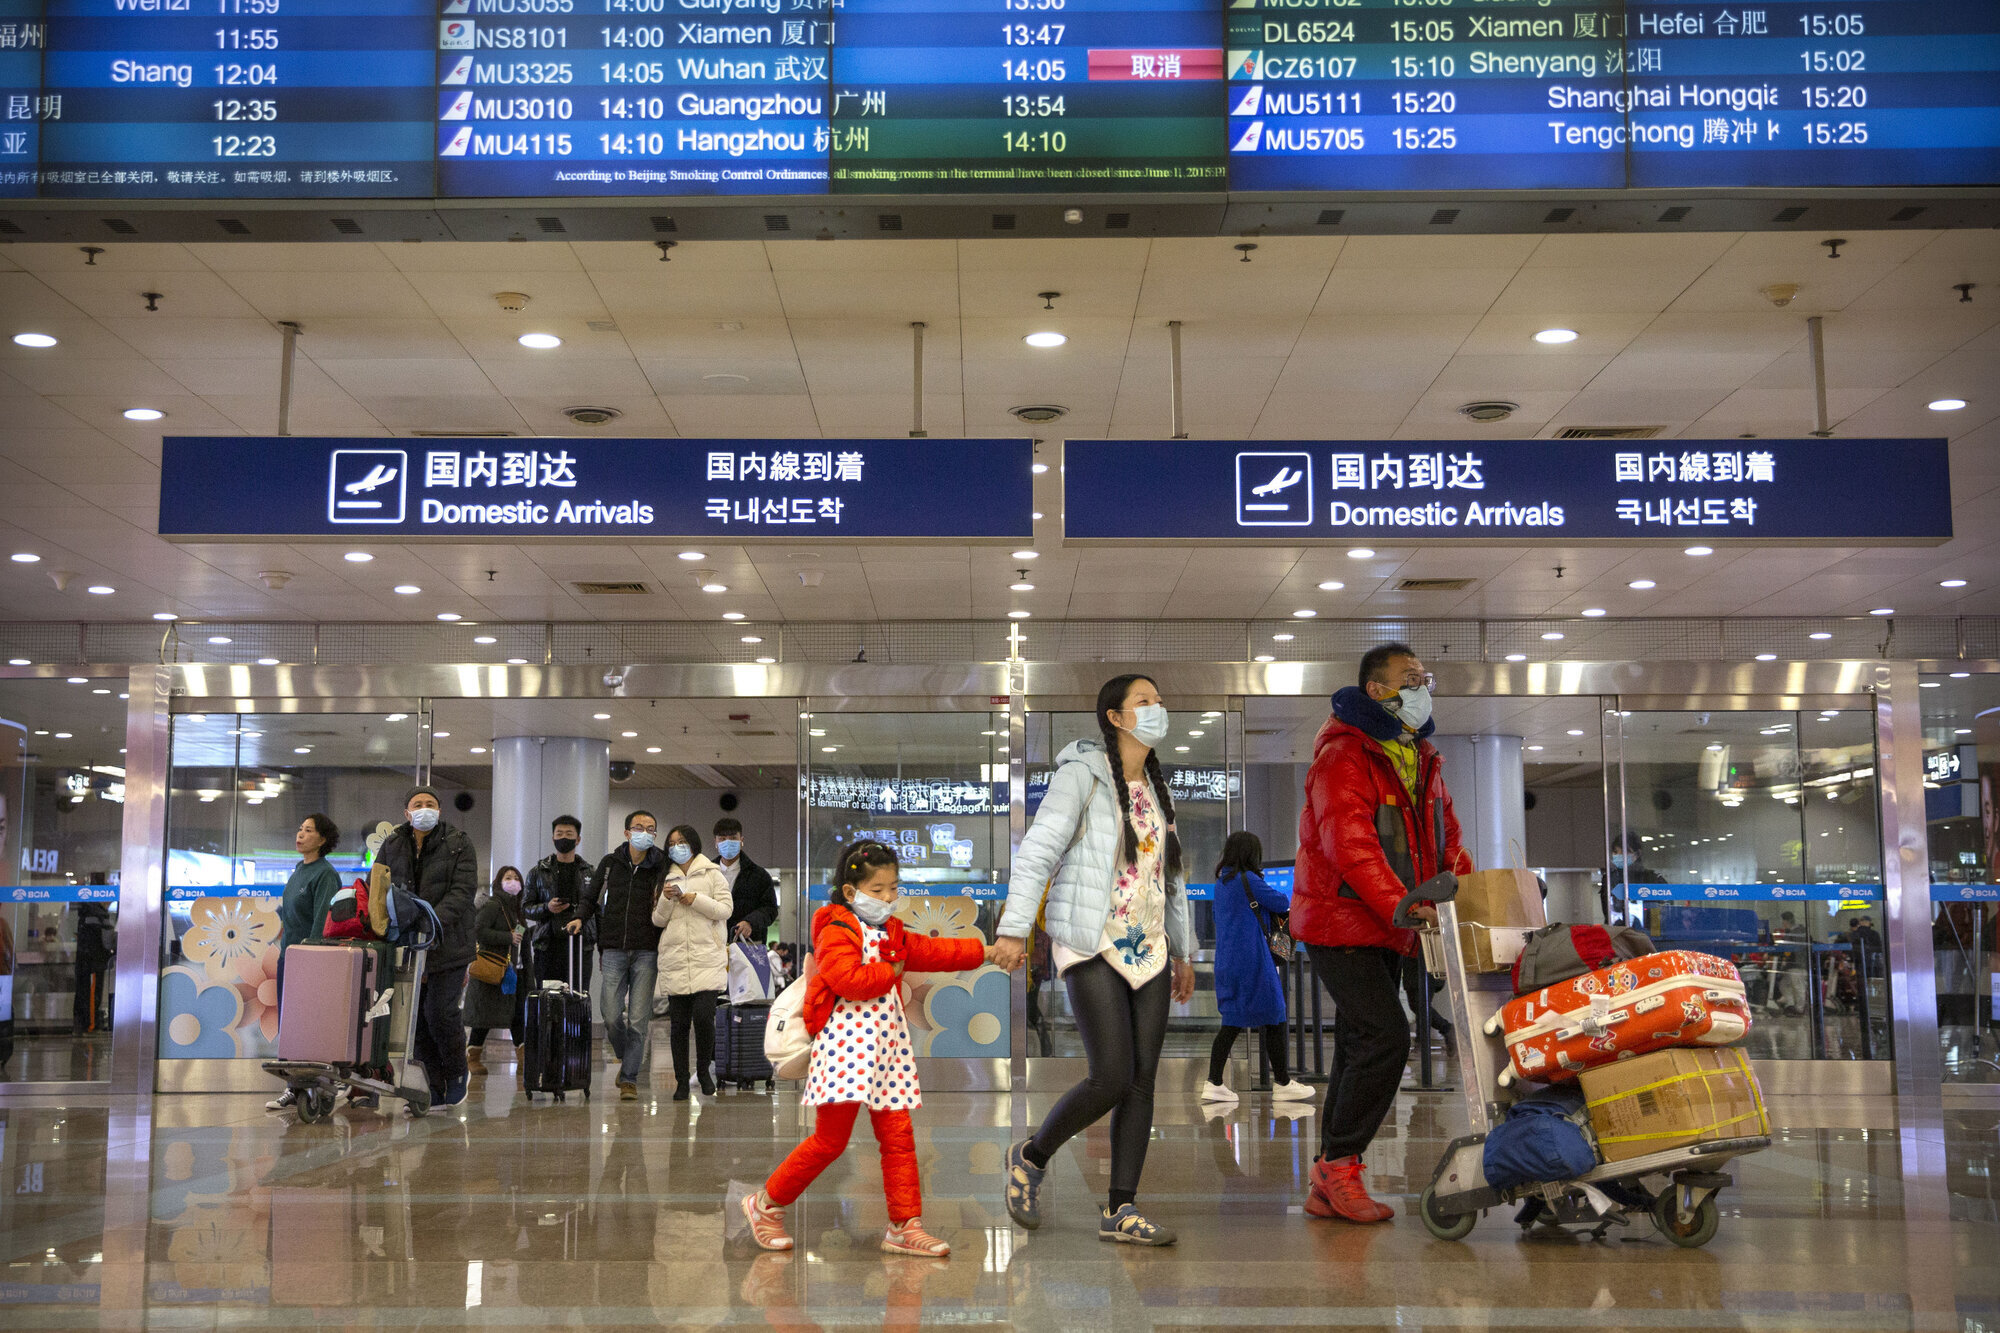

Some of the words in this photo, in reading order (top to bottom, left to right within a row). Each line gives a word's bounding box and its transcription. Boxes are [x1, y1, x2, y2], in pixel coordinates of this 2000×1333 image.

[219, 0, 279, 14] 11:59
[215, 29, 279, 49] 11:55
[476, 28, 567, 48] NS8101
[601, 27, 664, 47] 14:00
[678, 23, 772, 44] Xiamen
[781, 20, 835, 46] 厦门
[1002, 25, 1065, 46] 13:47
[1264, 22, 1355, 43] DL6524
[1390, 21, 1454, 42] 15:05
[1468, 16, 1563, 38] Xiamen
[1573, 12, 1628, 39] 厦门
[1640, 13, 1704, 34] Hefei
[1712, 10, 1768, 35] 合肥
[1799, 15, 1864, 36] 15:05
[112, 60, 193, 88] Shang
[214, 64, 278, 86] 12:04
[475, 63, 573, 84] MU3325
[601, 62, 664, 83] 14:05
[677, 58, 766, 79] Wuhan
[774, 55, 828, 81] 武汉
[1002, 60, 1066, 81] 14:05
[1131, 54, 1181, 79] 取消
[1264, 58, 1357, 79] CZ6107
[1391, 56, 1455, 78] 15:10
[1469, 51, 1596, 78] Shenyang
[1605, 48, 1662, 74] 沈阳
[1800, 50, 1865, 72] 15:02
[8, 94, 62, 120] 昆明
[213, 100, 277, 121] 12:35
[474, 98, 573, 120] MU3010
[600, 98, 664, 119] 14:10
[677, 93, 822, 121] Guangzhou
[833, 90, 886, 117] 广州
[1002, 96, 1065, 117] 13:54
[1265, 92, 1362, 115] MU5111
[1391, 91, 1456, 113] 15:20
[1548, 84, 1671, 113] Shanghai
[1802, 86, 1867, 108] 15:20
[212, 136, 276, 157] 12:23
[474, 134, 572, 155] MU4115
[600, 133, 664, 155] 14:10
[678, 128, 805, 157] Hangzhou
[813, 126, 869, 153] 杭州
[1003, 131, 1066, 153] 14:10
[1266, 128, 1365, 150] MU5705
[1392, 127, 1457, 149] 15:25
[1548, 121, 1694, 149] Tengchong
[1702, 117, 1757, 145] 腾冲
[1803, 122, 1868, 144] 15:25
[555, 170, 613, 184] According
[614, 171, 626, 181] to
[628, 170, 667, 184] Beijing
[670, 169, 720, 184] Smoking
[722, 169, 763, 181] Control
[425, 450, 578, 488] 国内到达
[706, 450, 865, 482] 国内線到着
[1331, 452, 1485, 490] 国内到达
[1614, 451, 1776, 483] 国内線到着
[421, 498, 549, 524] Domestic
[554, 499, 655, 524] Arrivals
[704, 496, 845, 524] 국내선도착
[1330, 501, 1458, 526] Domestic
[1463, 501, 1565, 527] Arrivals
[1614, 497, 1758, 526] 국내선도착
[28, 890, 50, 899] BCIA
[93, 890, 116, 898] BCIA
[909, 888, 930, 896] BCIA
[976, 888, 997, 896] BCIA
[1651, 888, 1672, 897] BCIA
[1718, 888, 1740, 897] BCIA
[1785, 889, 1806, 897] BCIA
[1852, 889, 1874, 897] BCIA
[1975, 888, 1998, 897] BCIA
